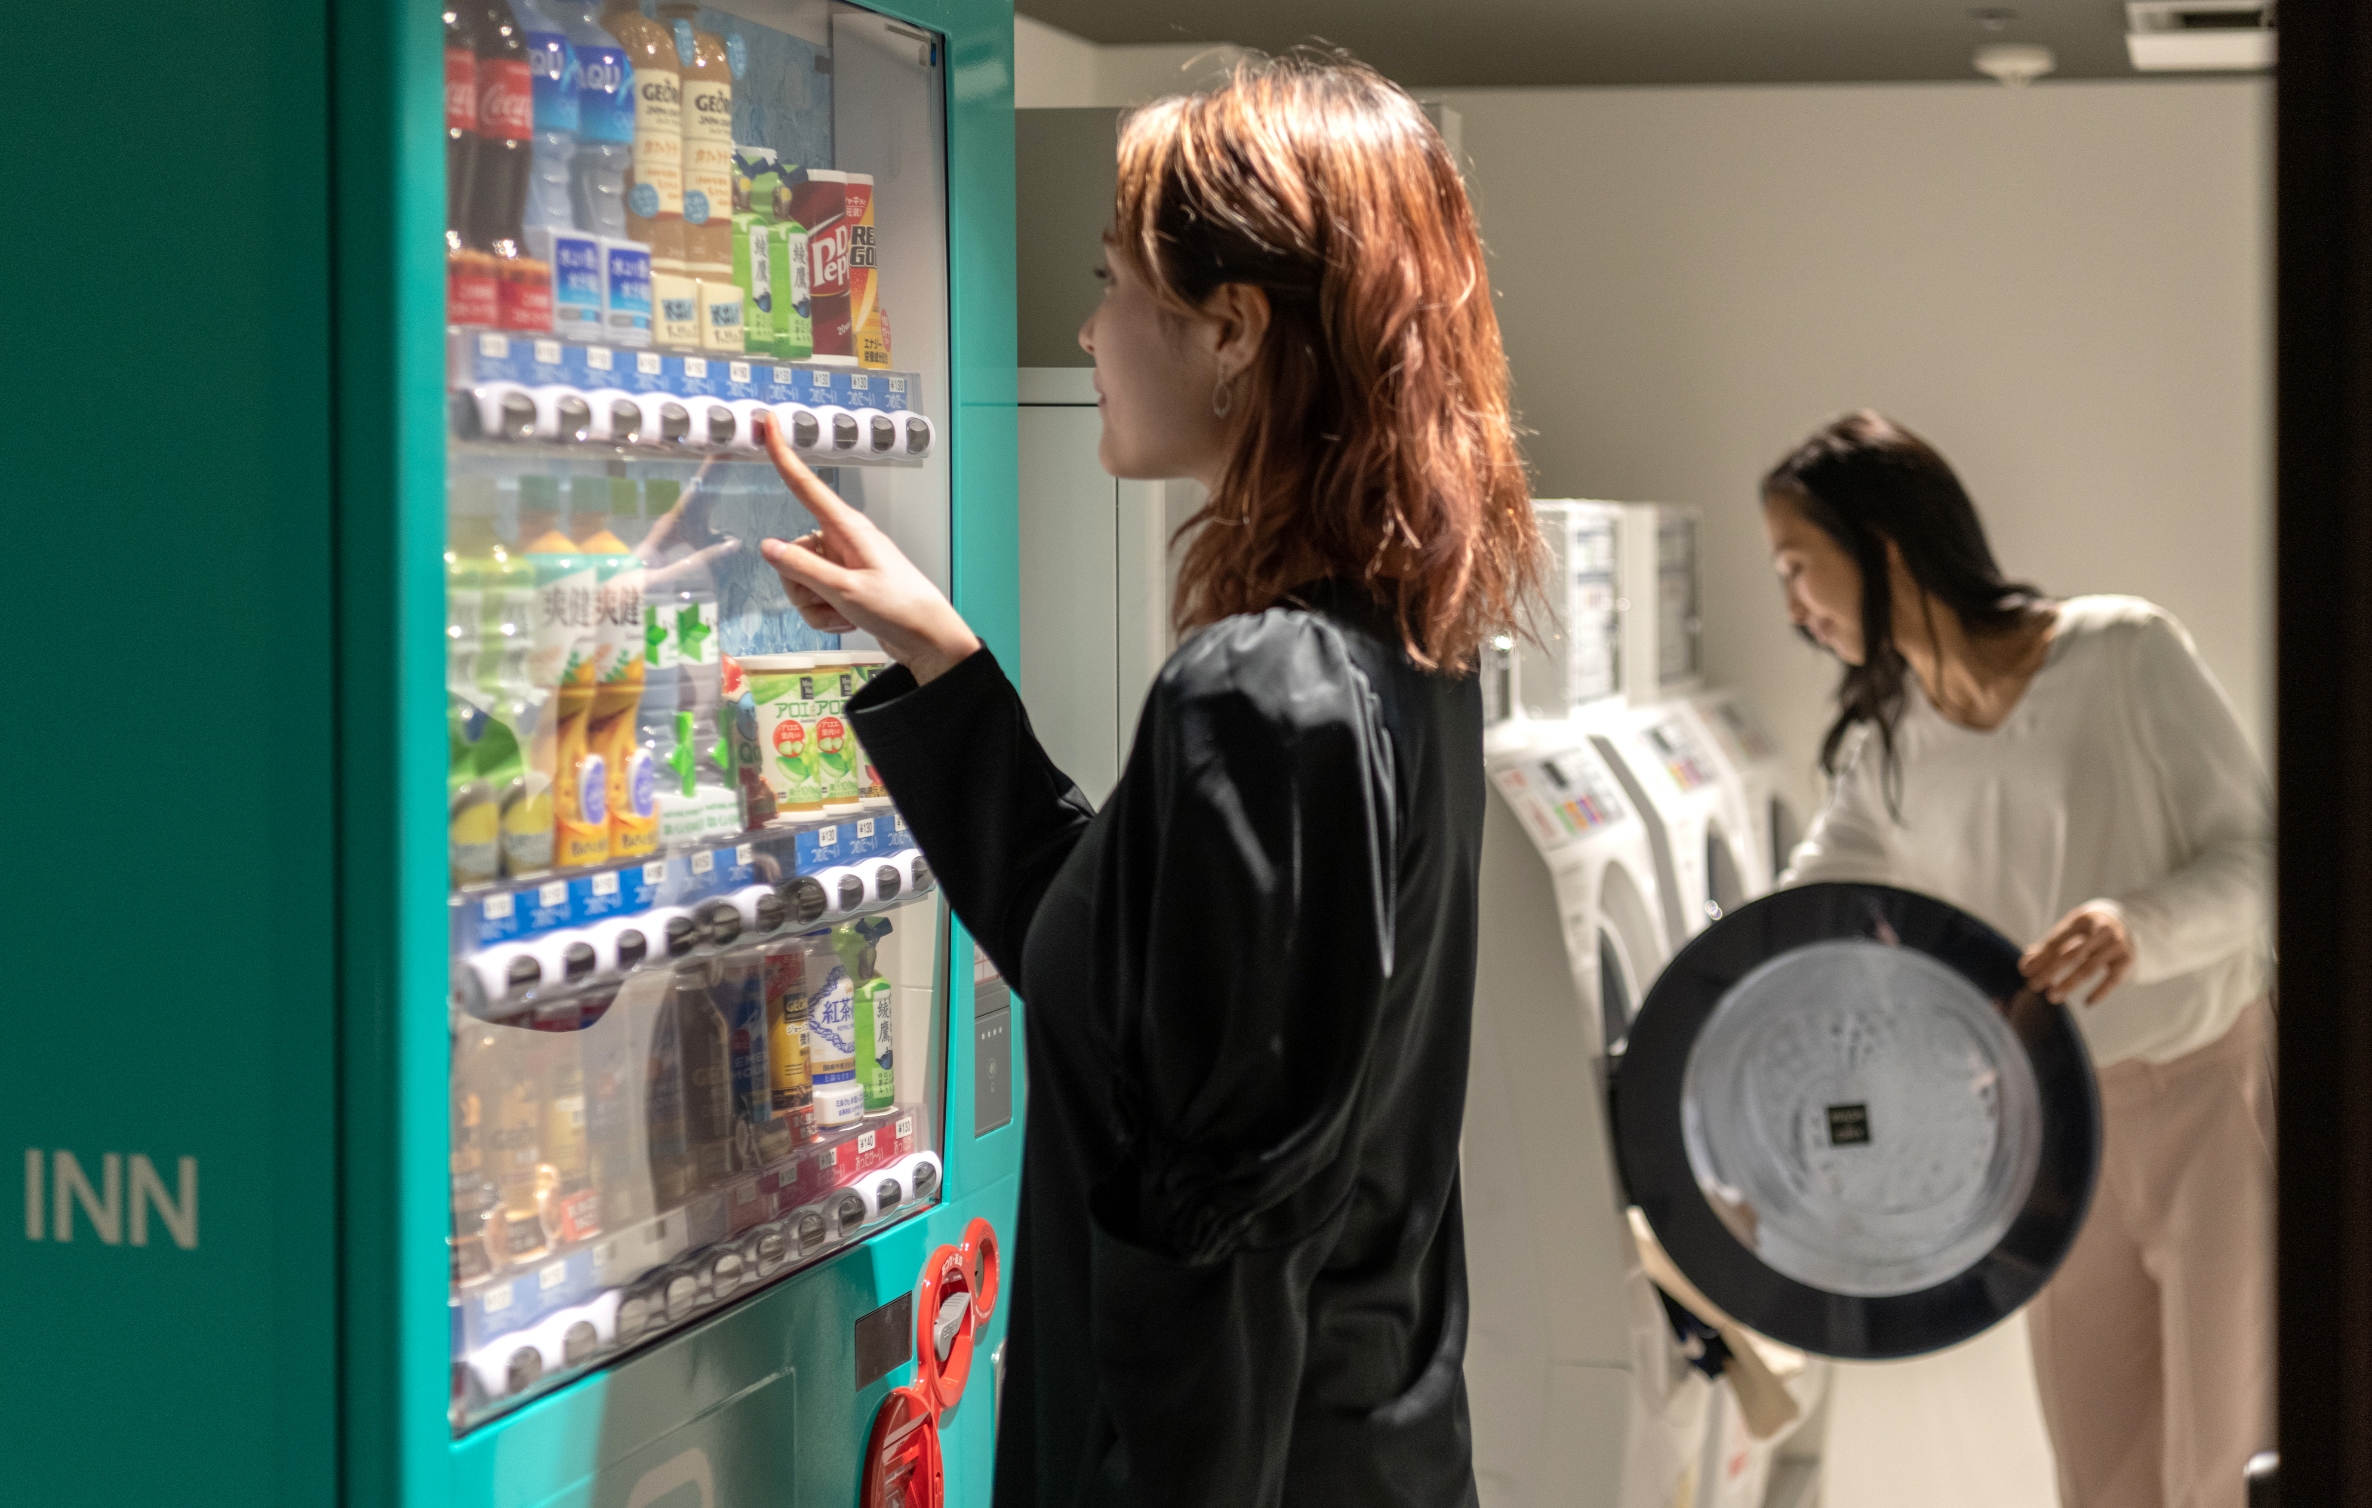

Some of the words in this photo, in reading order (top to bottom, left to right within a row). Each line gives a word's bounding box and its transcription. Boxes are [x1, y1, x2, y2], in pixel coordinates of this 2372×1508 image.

[864, 338, 883, 350] エナジー
[775, 369, 790, 382] ¥130
[815, 373, 829, 386] ¥130
[853, 377, 867, 389] ¥130
[890, 380, 904, 392] ¥130
[885, 394, 906, 409] つめた〜
[859, 821, 873, 835] ¥130
[821, 828, 835, 843] ¥130
[877, 1000, 890, 1042] 綾鷹
[898, 1120, 911, 1134] ¥130
[860, 1135, 874, 1149] ¥140
[25, 1147, 198, 1250] INN
